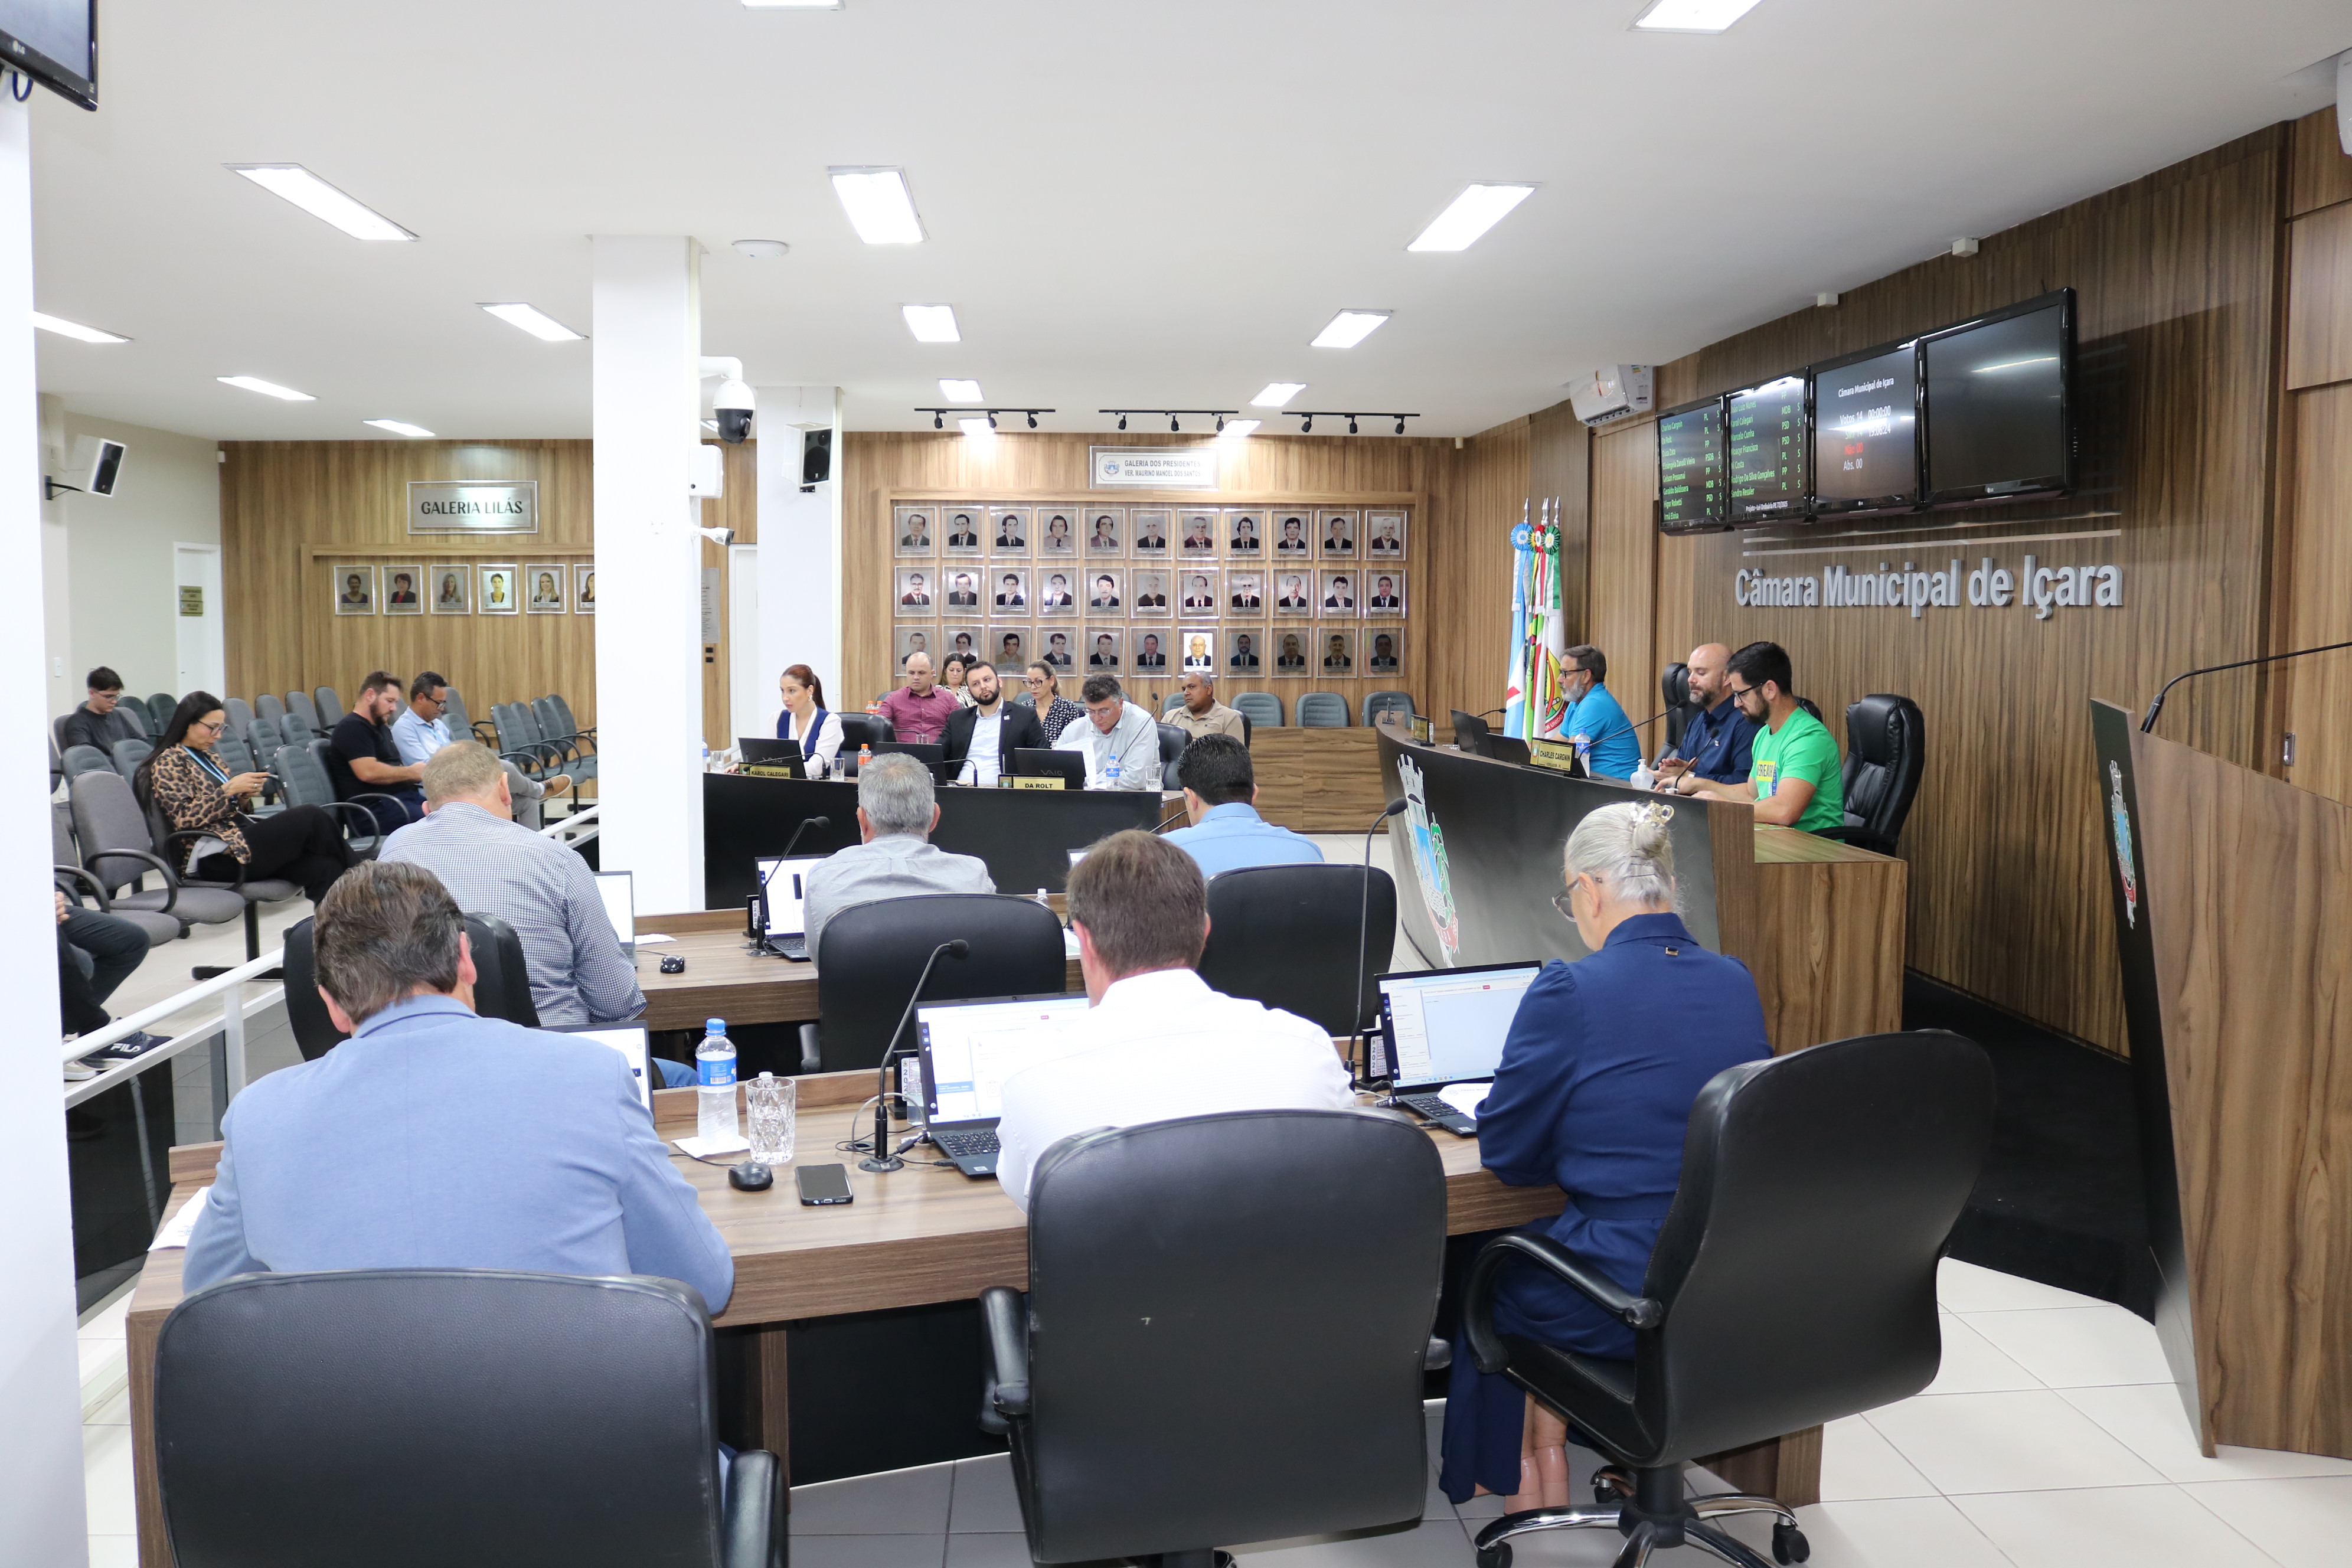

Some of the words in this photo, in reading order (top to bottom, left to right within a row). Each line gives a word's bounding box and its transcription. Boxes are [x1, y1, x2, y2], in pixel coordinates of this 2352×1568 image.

[18, 44, 25, 54] LG
[1838, 388, 1854, 397] Câmara
[1855, 380, 1876, 393] Municipal
[1876, 378, 1881, 388] de
[1883, 378, 1894, 388] Içara
[1782, 405, 1791, 414] MDB
[1798, 403, 1801, 411] S
[1840, 414, 1854, 424] Votos
[1857, 410, 1863, 422] 14
[1868, 405, 1891, 420] 00:00:00
[1798, 418, 1801, 426] S
[1782, 436, 1790, 445] PSD
[1798, 433, 1801, 442] S
[1704, 440, 1710, 448] PP
[1706, 452, 1714, 461] PSDB
[1782, 452, 1787, 460] PL
[1798, 449, 1801, 458] S
[1798, 464, 1801, 472] S
[1843, 460, 1854, 471] Abs.
[1856, 458, 1863, 469] 00
[1782, 466, 1788, 475] PP
[1749, 472, 1757, 481] Silva
[1706, 480, 1714, 488] MDB
[1782, 482, 1787, 490] PL
[1798, 479, 1801, 488] S
[421, 501, 480, 514] GALERIA
[485, 497, 522, 514] LILÁS
[1735, 568, 1819, 606] Câmara
[1823, 558, 1961, 618] Municipal
[1968, 557, 2014, 606] de
[2022, 554, 2124, 619] Içara
[1550, 715, 1563, 727] UNIDO
[1540, 750, 1554, 759] CHARLES
[1555, 752, 1570, 761] CARGNIN
[110, 1043, 141, 1053] FILA
